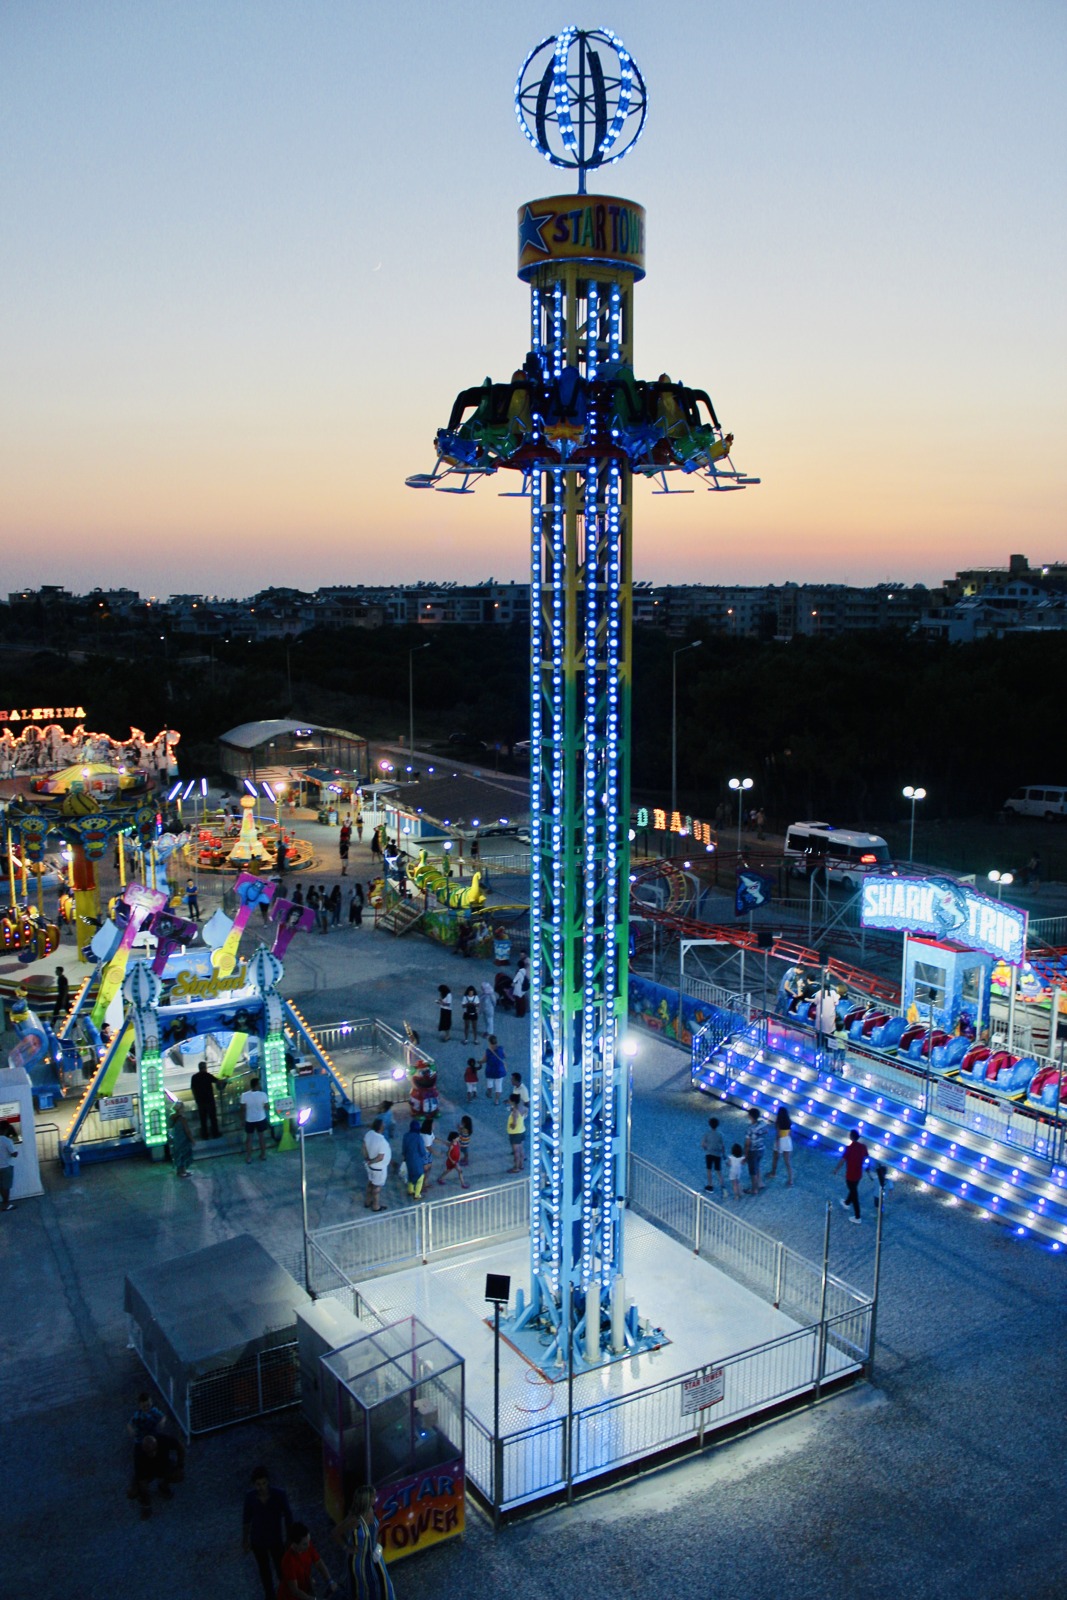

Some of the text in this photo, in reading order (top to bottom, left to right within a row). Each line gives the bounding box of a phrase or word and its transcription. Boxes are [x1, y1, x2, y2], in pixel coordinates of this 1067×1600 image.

[552, 204, 607, 253] STAR
[0, 706, 87, 721] BALERINA
[863, 884, 1021, 953] SHARK TRIP
[170, 965, 247, 998] Sinbad
[684, 1379, 701, 1391] STAR
[382, 1475, 455, 1521] STAR
[378, 1505, 458, 1550] TOWER
